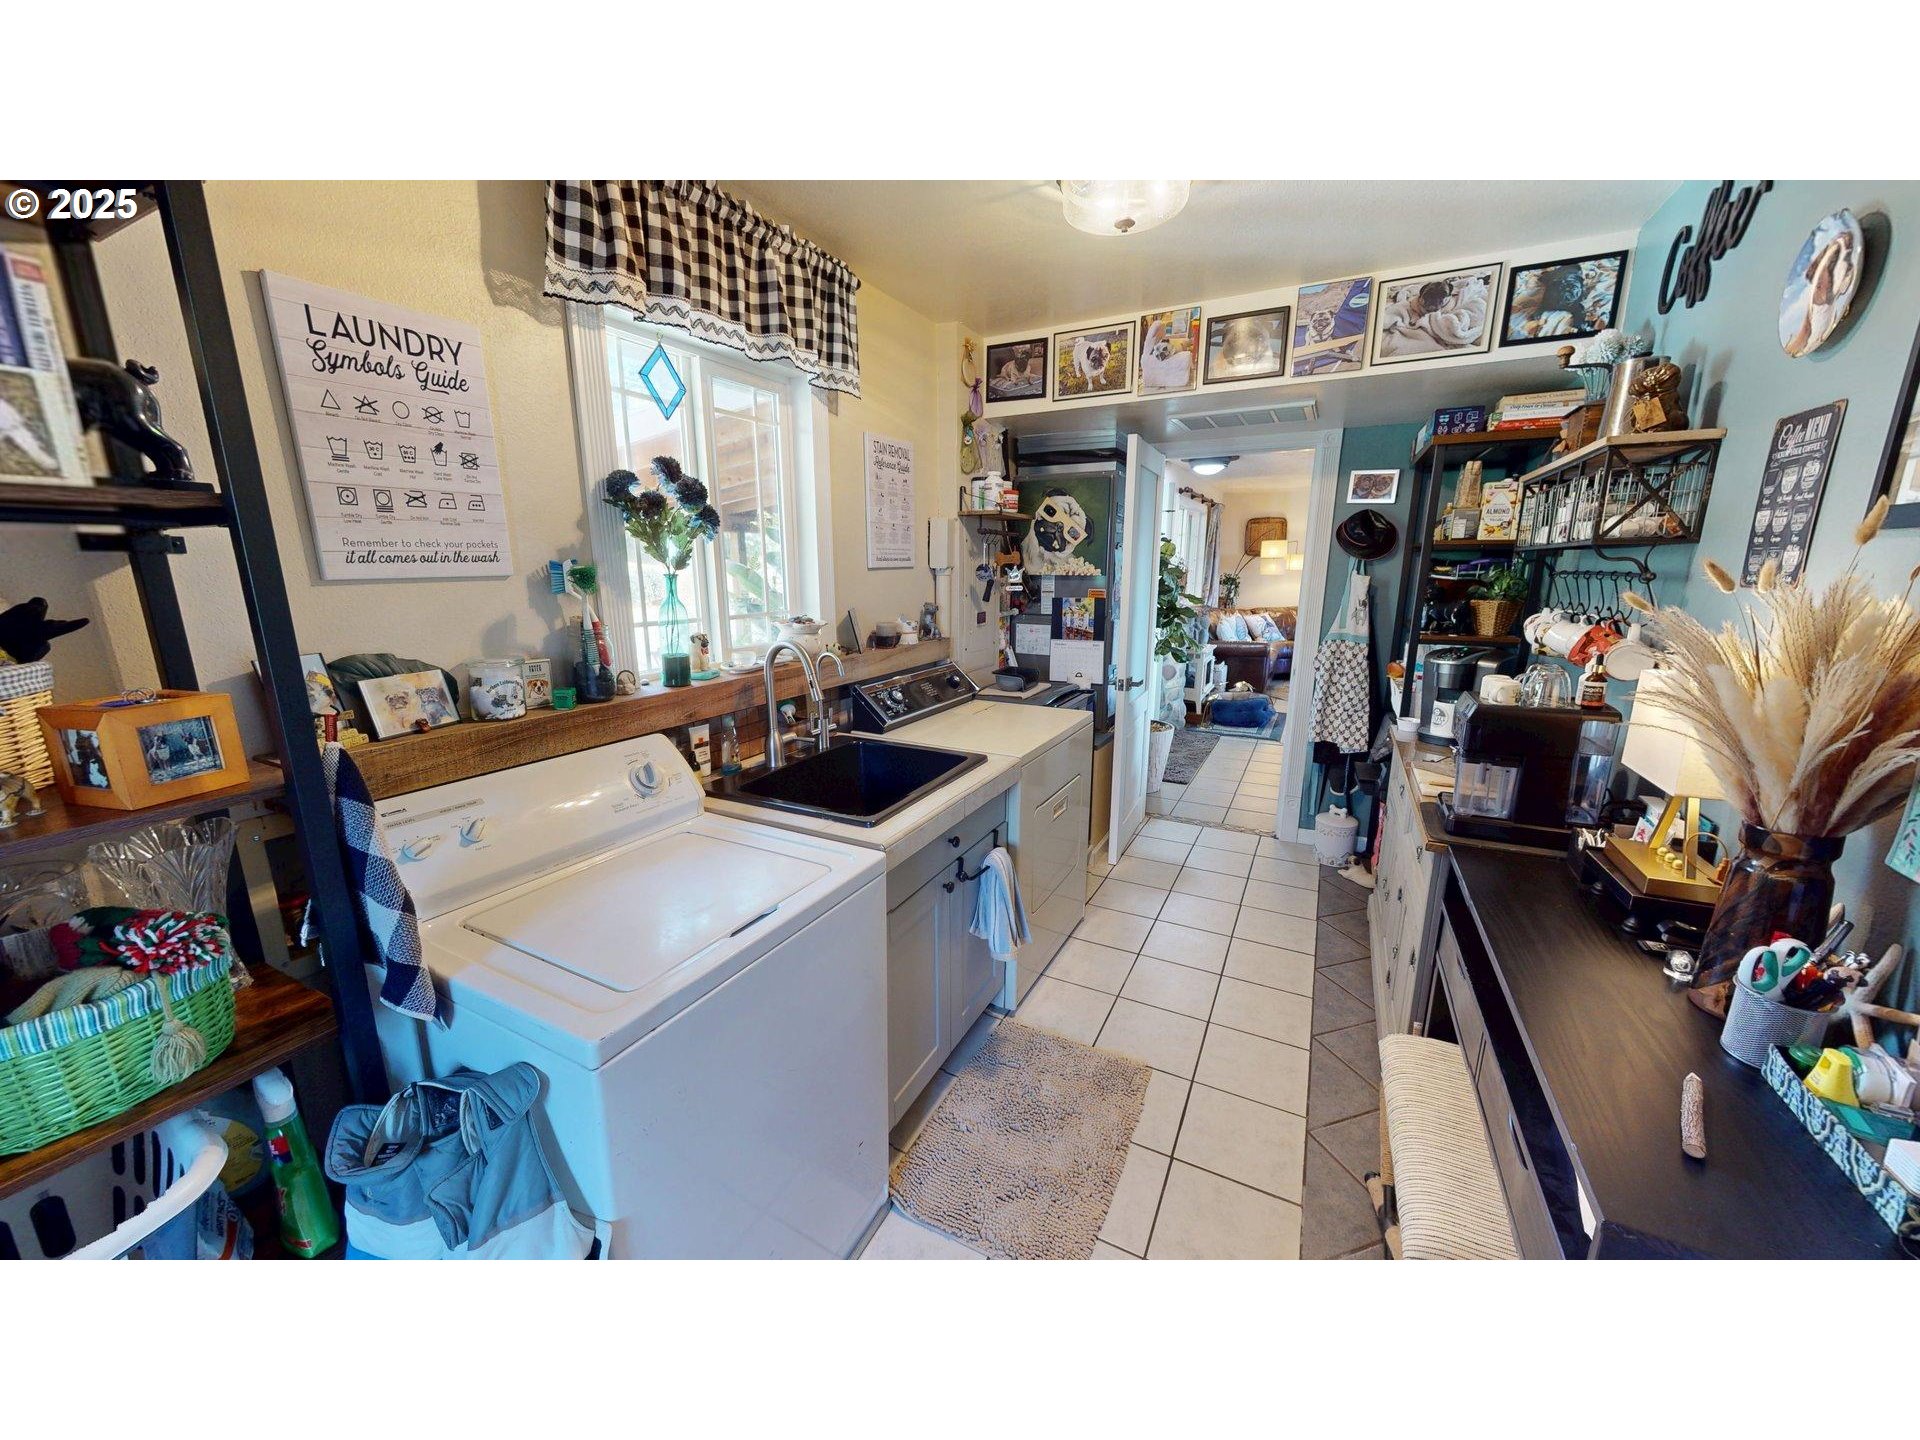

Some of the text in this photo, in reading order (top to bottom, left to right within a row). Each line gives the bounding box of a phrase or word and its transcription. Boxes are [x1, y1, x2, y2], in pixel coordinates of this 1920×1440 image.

[1658, 180, 1774, 315] Coffee
[304, 303, 463, 366] LAUNDRY
[306, 337, 470, 396] Symbols Guide
[1778, 413, 1833, 450] Coffee MENU
[341, 537, 499, 550] Remember to check your pockets
[345, 549, 501, 564] it all comes out in the wash
